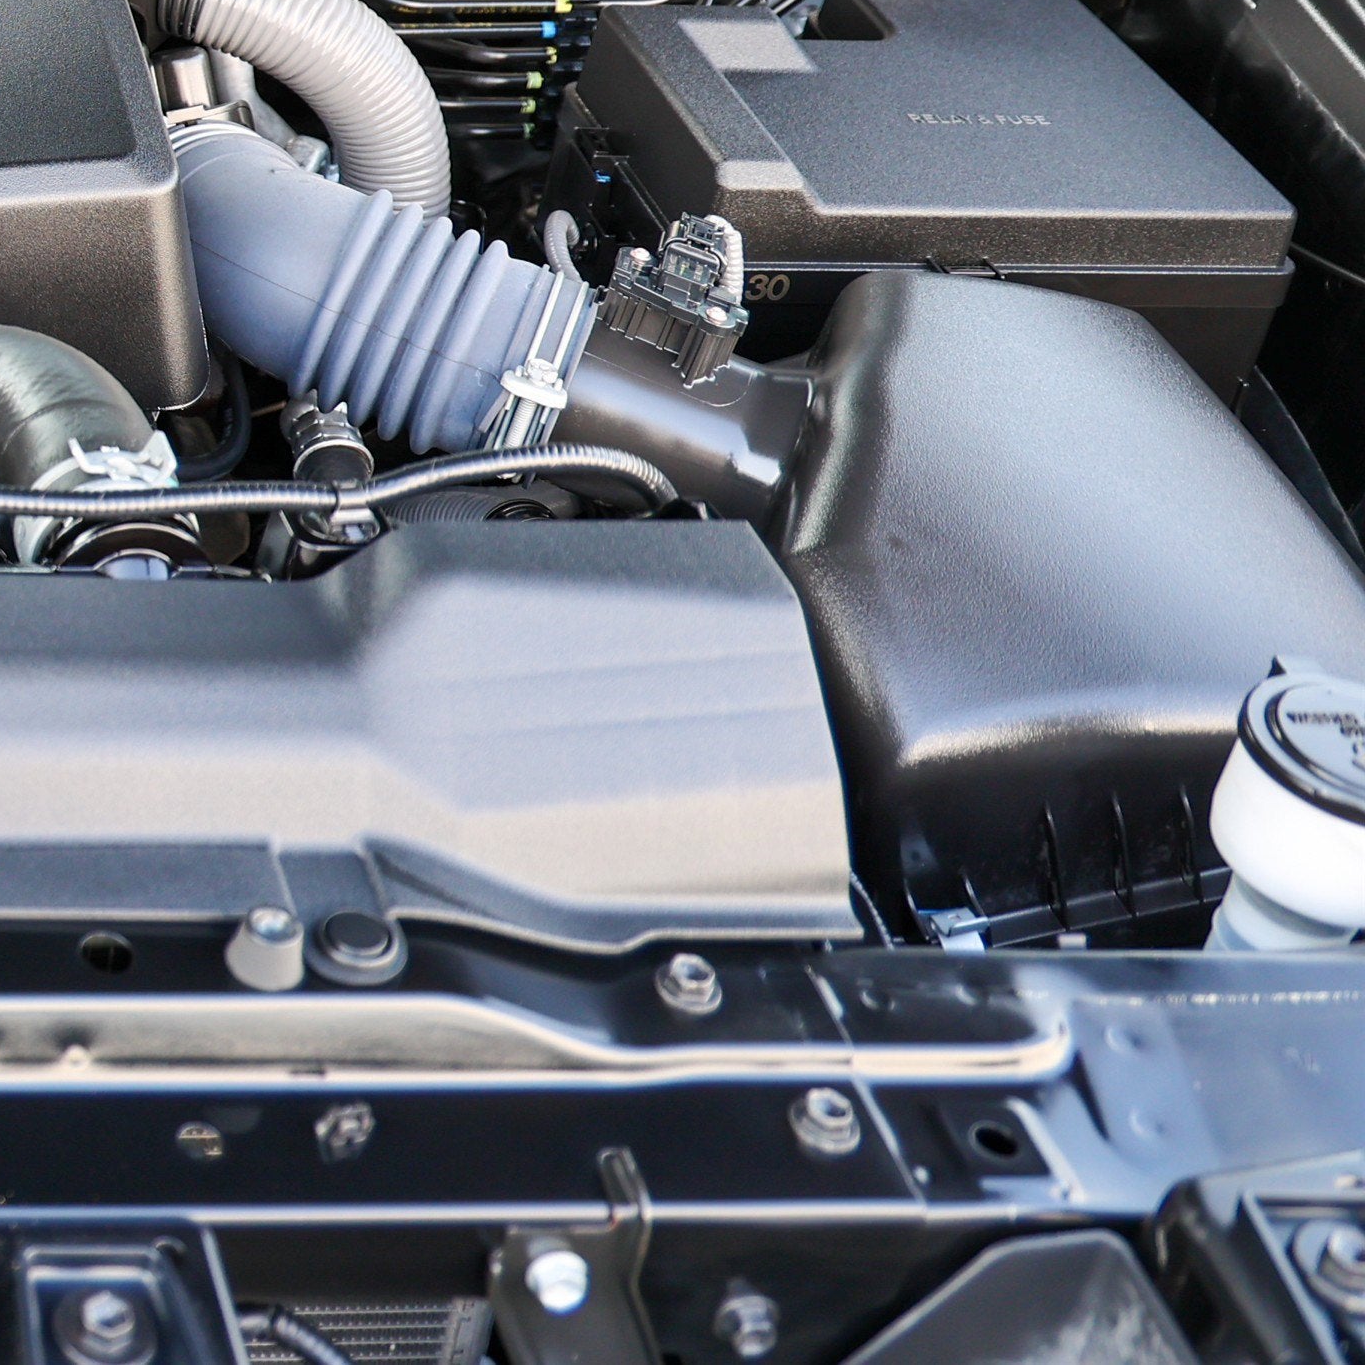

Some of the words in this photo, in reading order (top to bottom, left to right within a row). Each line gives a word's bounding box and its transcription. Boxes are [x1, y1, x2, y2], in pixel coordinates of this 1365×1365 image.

[906, 112, 973, 125] RELAY
[977, 114, 994, 125] &
[994, 113, 1053, 126] FUSE
[744, 273, 791, 301] 30
